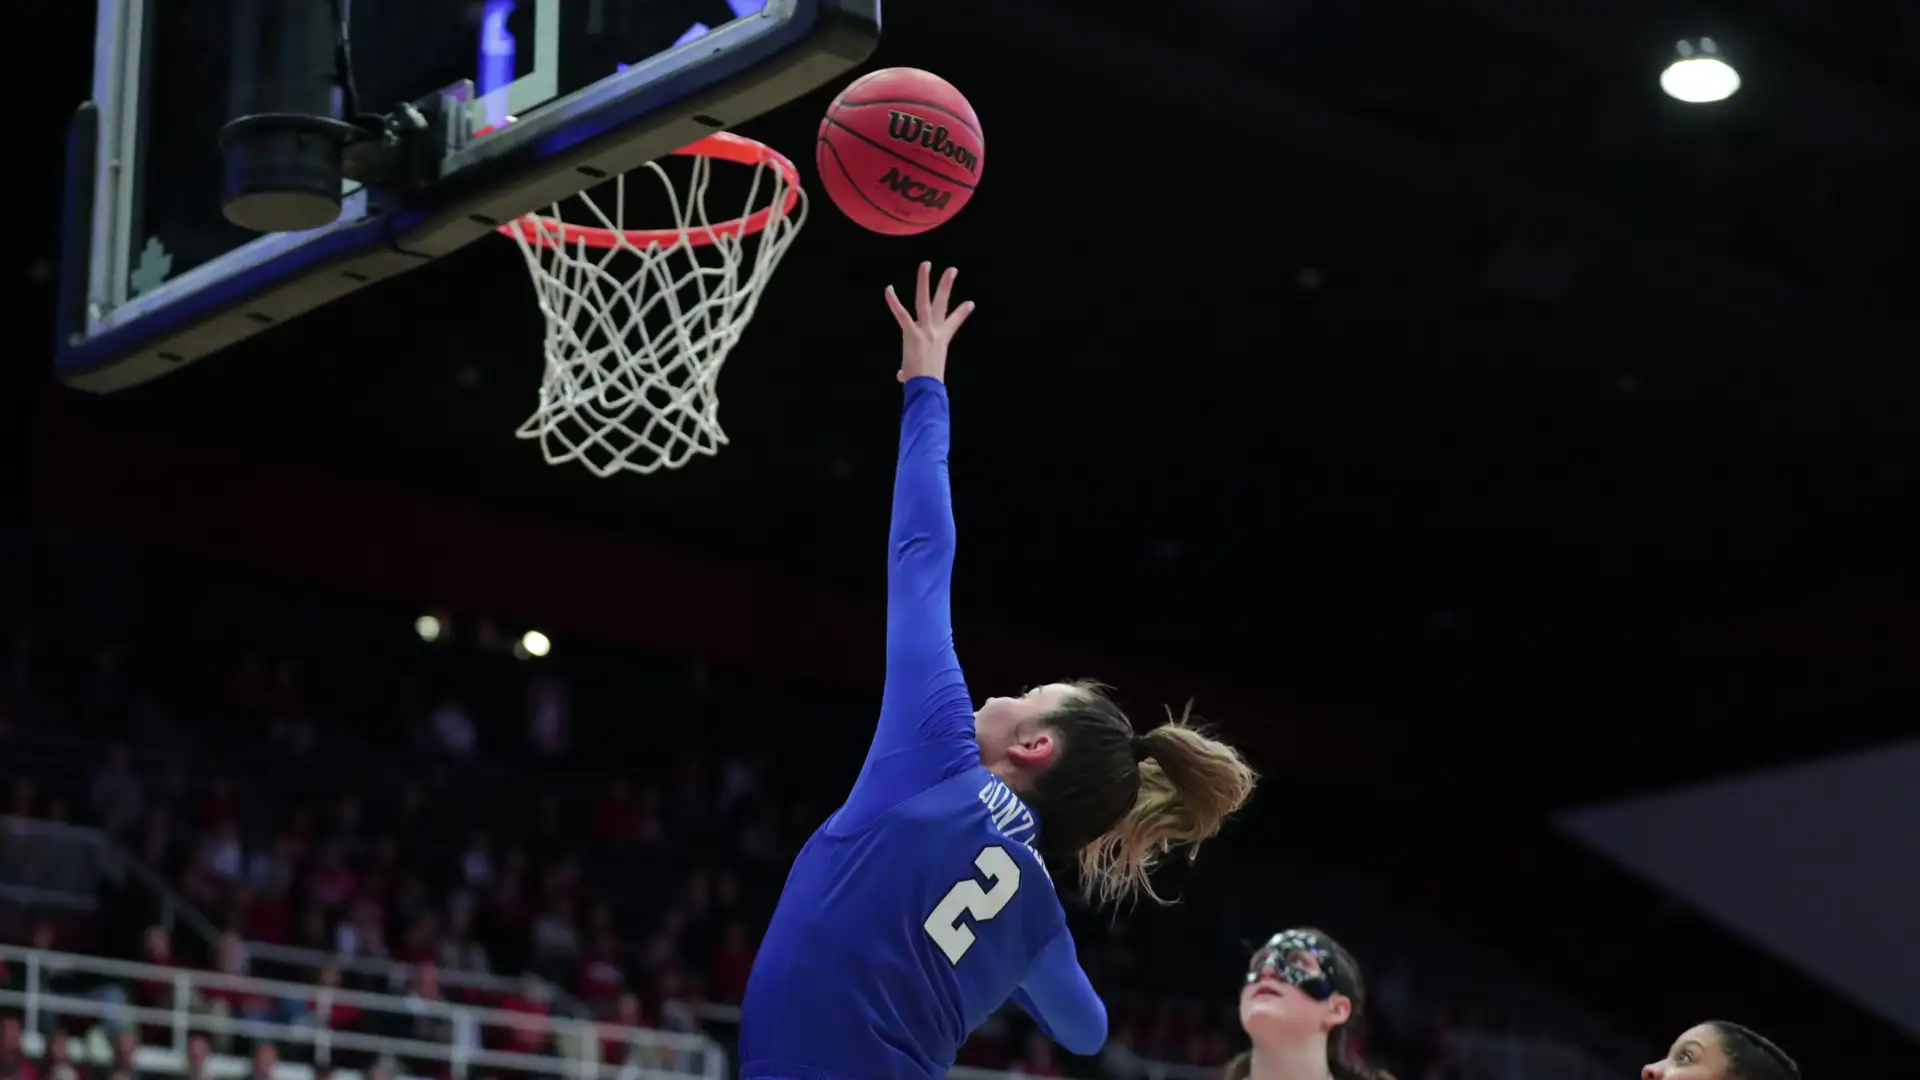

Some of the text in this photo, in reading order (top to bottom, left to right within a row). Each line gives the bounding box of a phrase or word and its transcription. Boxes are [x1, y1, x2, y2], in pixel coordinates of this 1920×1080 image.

[888, 110, 978, 173] Wilson
[880, 167, 952, 210] NCAA
[923, 845, 1021, 966] 2
